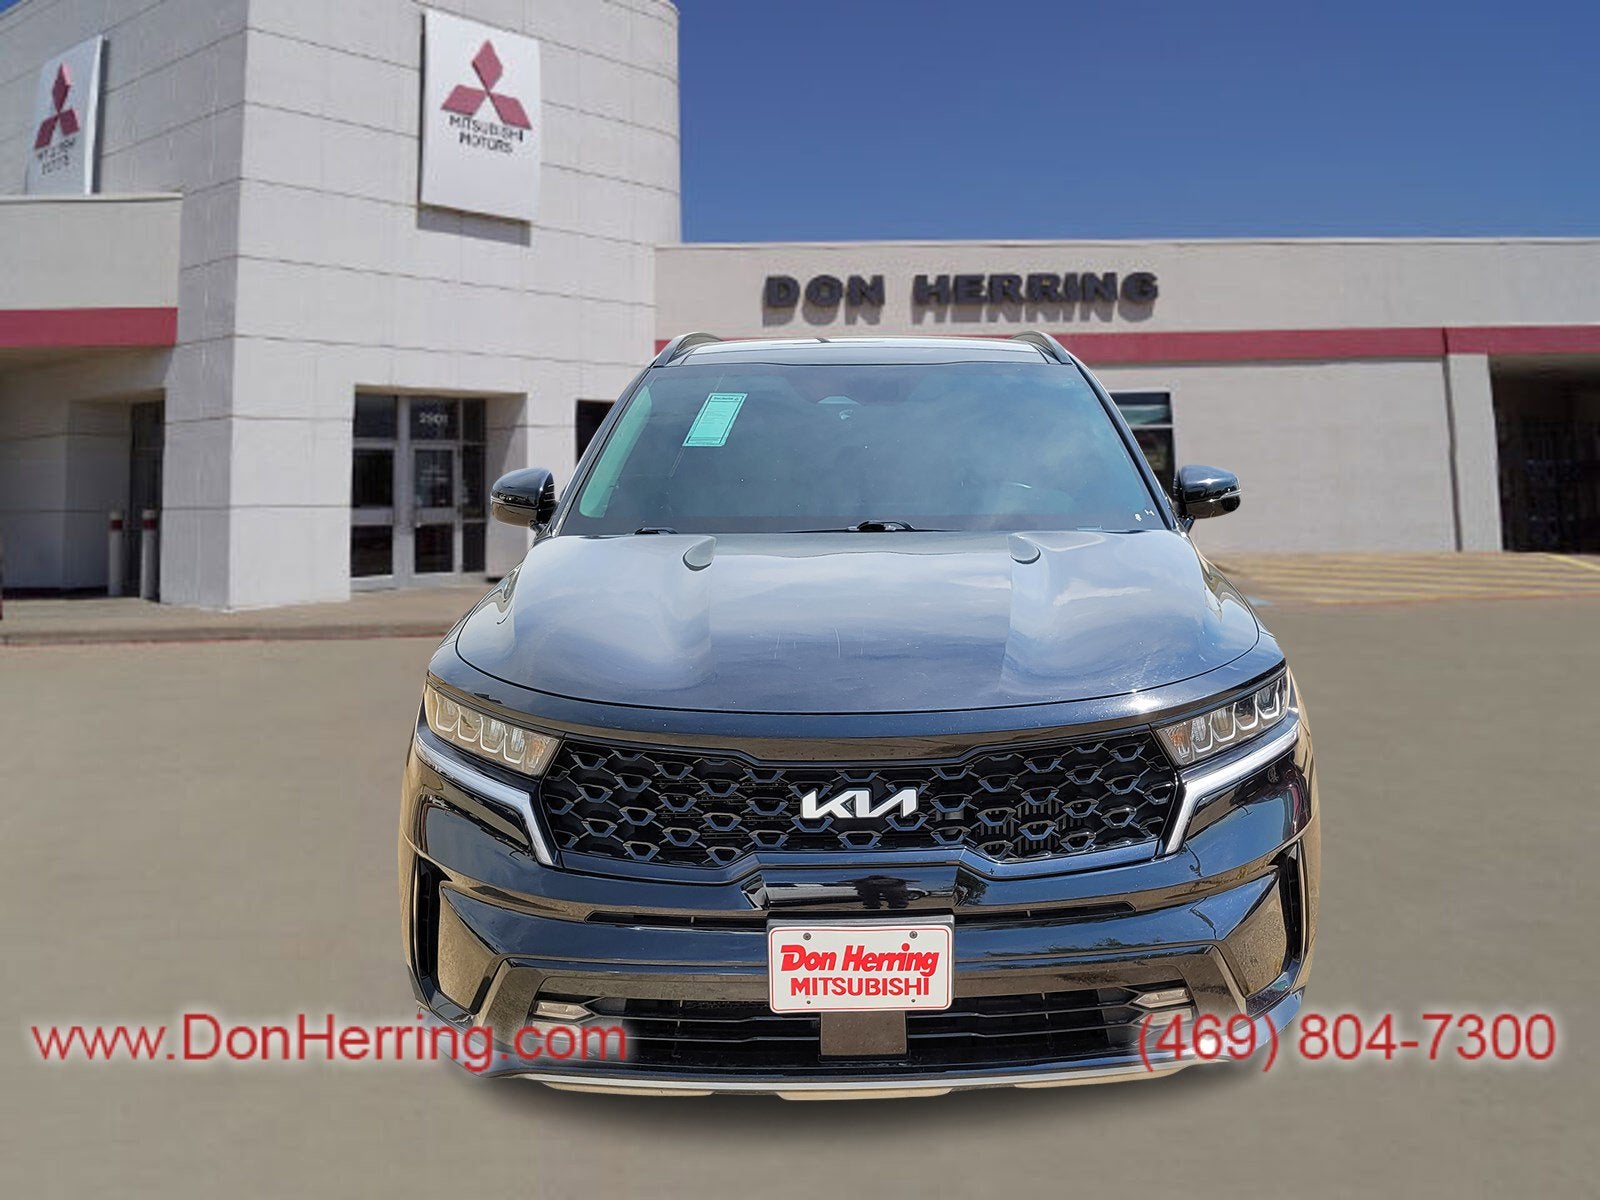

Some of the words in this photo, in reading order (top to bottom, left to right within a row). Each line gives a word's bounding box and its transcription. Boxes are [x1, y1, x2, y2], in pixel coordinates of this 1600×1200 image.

[459, 131, 513, 153] MOTORS
[764, 274, 885, 308] DON
[912, 272, 1159, 306] HERRING
[801, 788, 918, 819] KIA
[780, 945, 837, 971] Don
[841, 943, 939, 977] Herring
[790, 977, 930, 996] MITSUBISHI
